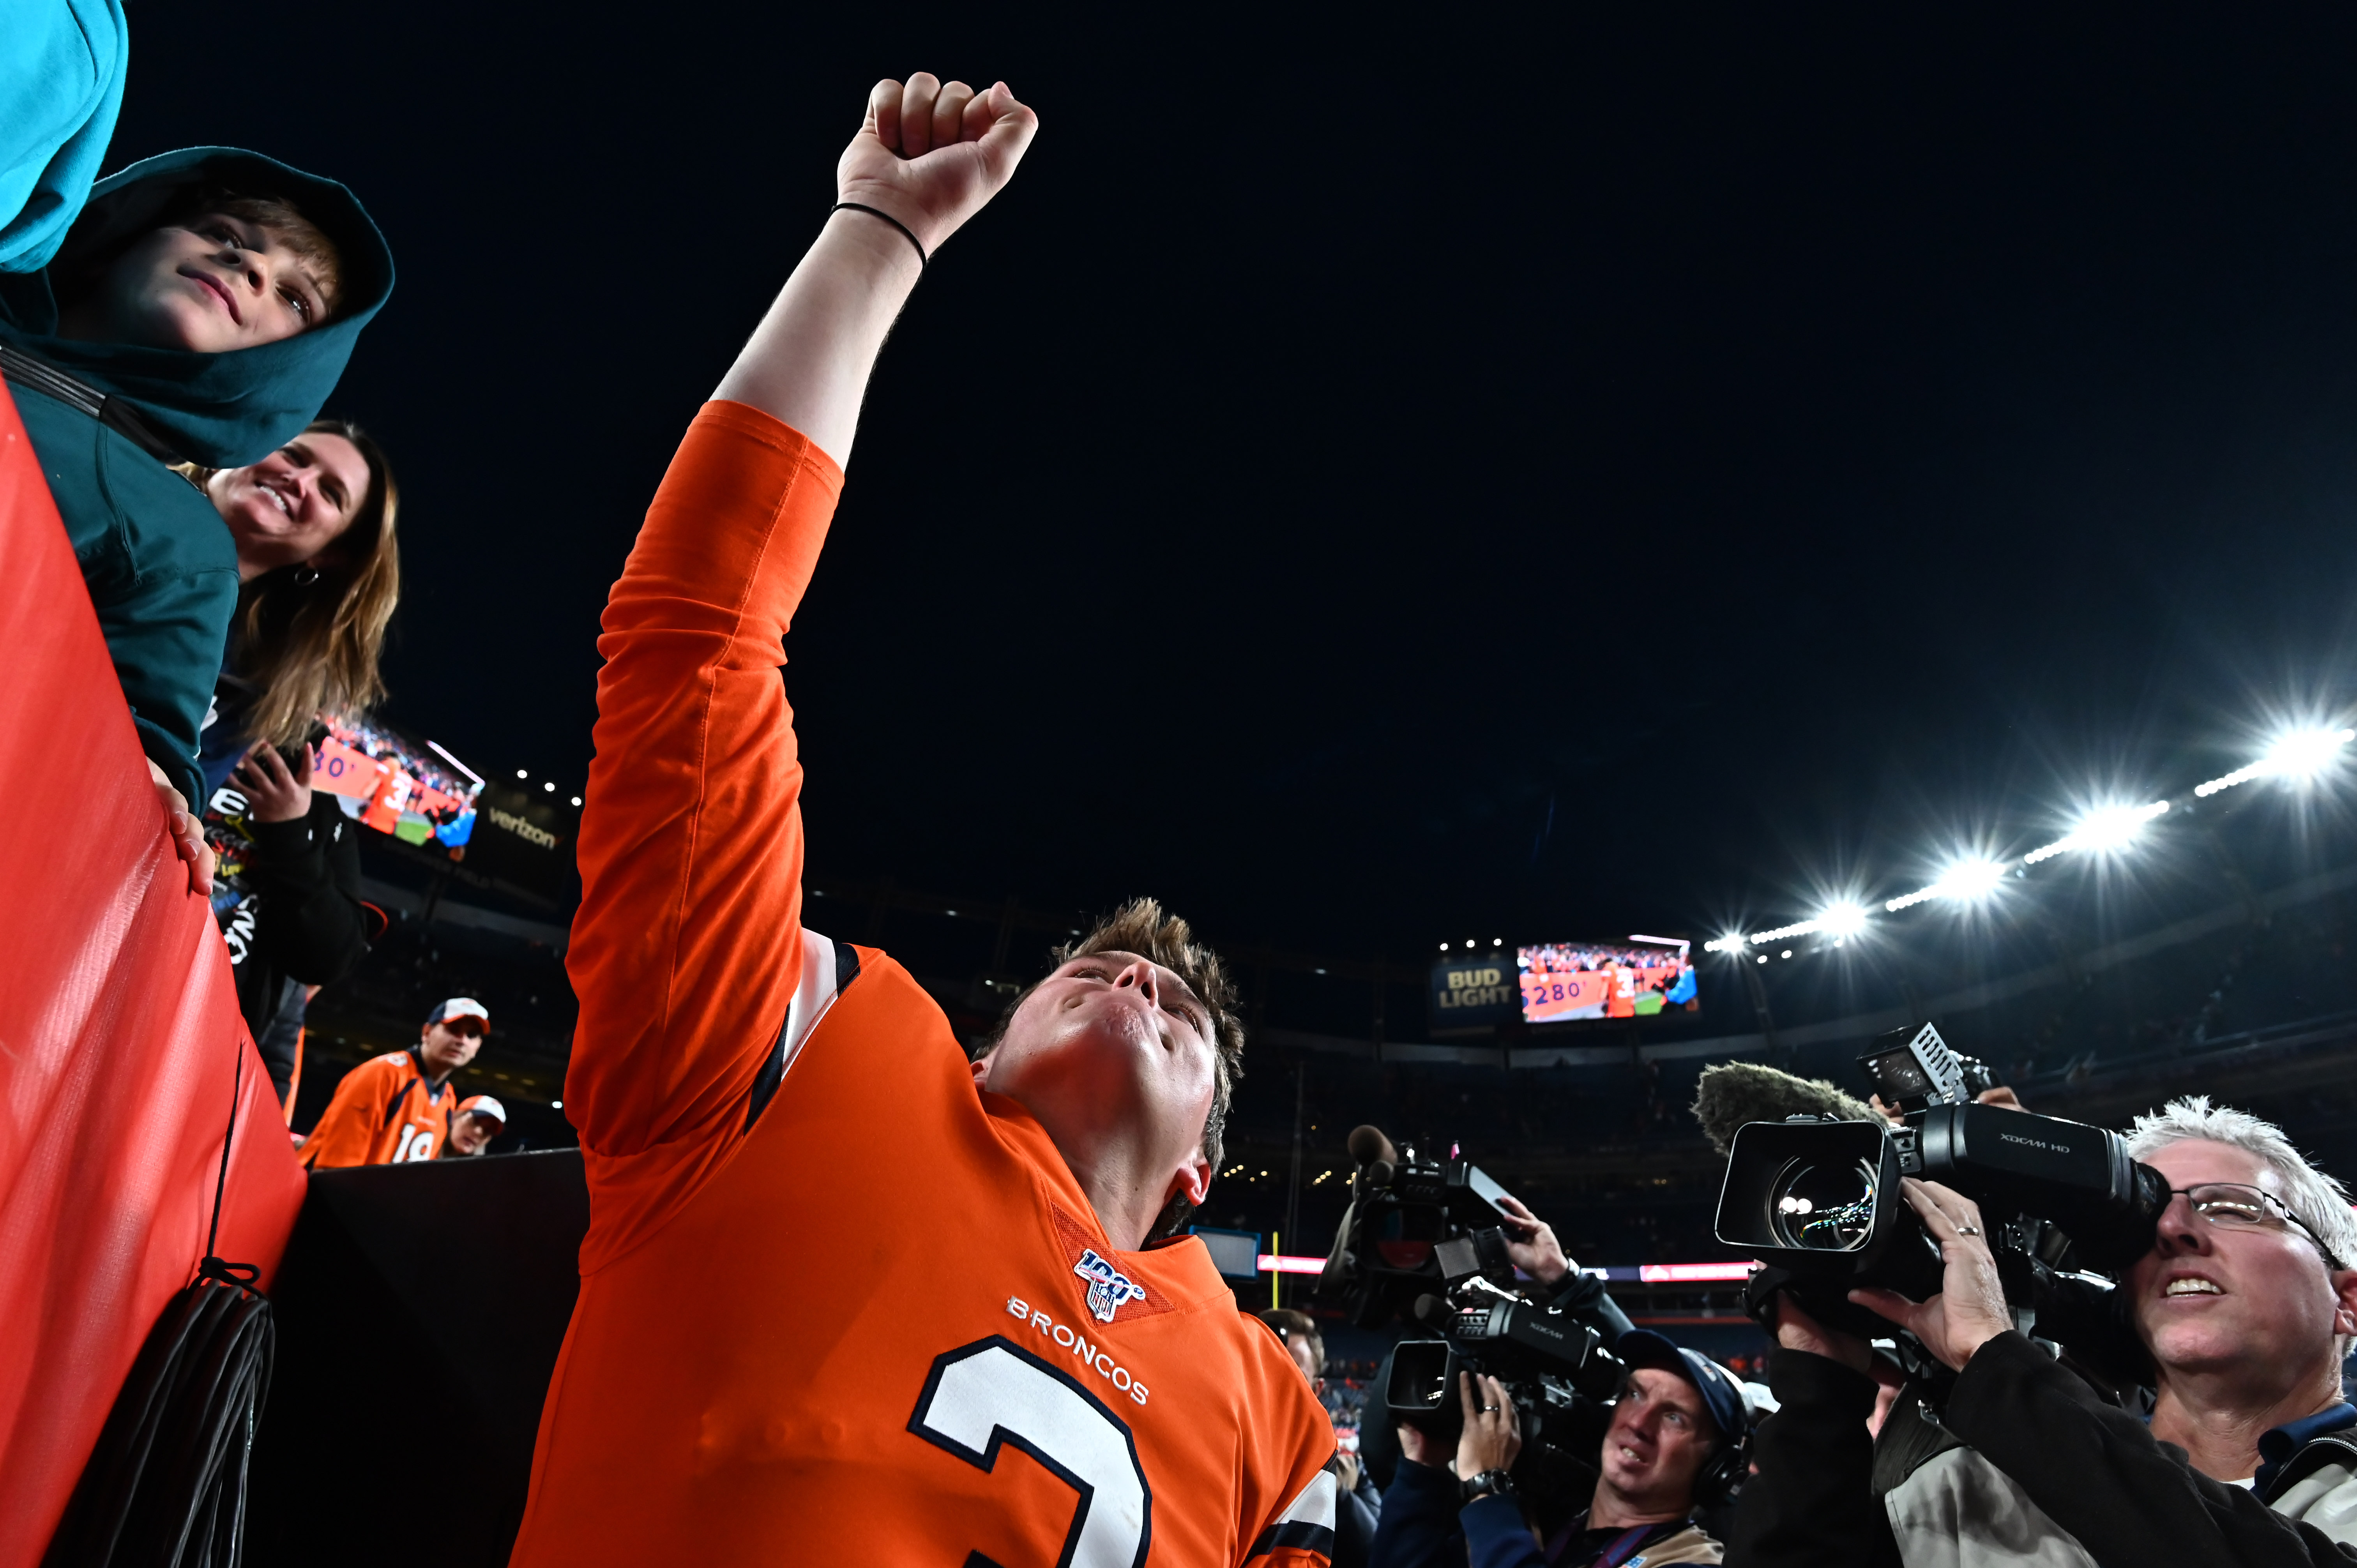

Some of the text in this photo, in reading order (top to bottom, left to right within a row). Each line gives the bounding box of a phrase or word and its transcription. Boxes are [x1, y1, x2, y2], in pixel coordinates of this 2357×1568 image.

[489, 807, 555, 850] verizon
[1448, 968, 1501, 989] BUD
[1439, 985, 1511, 1008] LIGHT
[2000, 1133, 2070, 1153] XDCAM HD
[1092, 1292, 1111, 1315] NFL
[1530, 1322, 1564, 1340] XDCAM
[1005, 1295, 1149, 1406] BRONCOS
